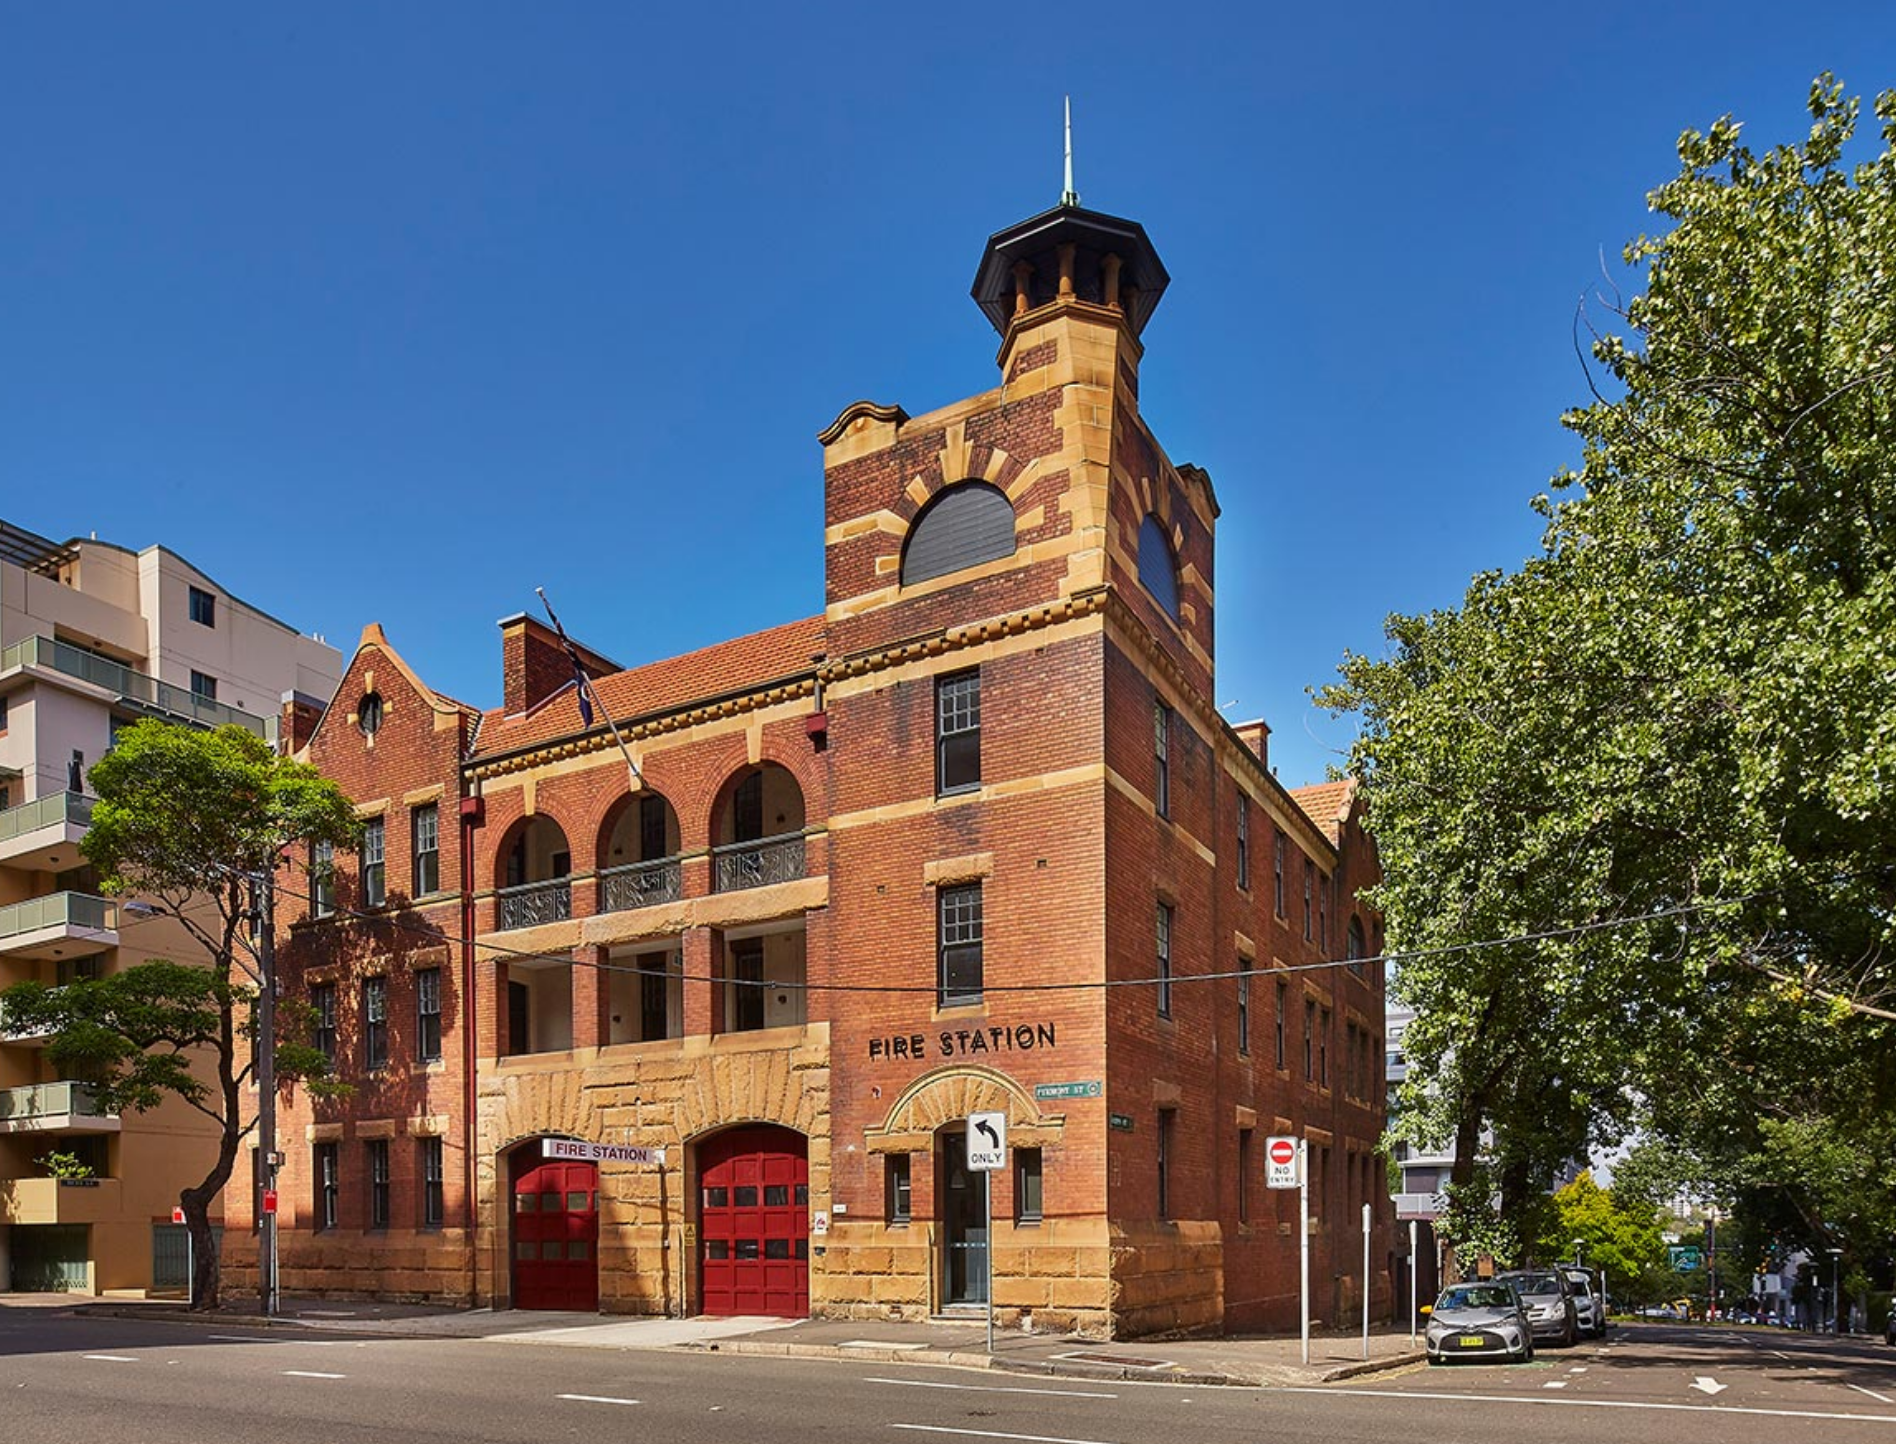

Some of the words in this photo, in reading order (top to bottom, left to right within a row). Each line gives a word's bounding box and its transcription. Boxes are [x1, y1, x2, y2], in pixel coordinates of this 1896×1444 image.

[869, 1034, 925, 1061] FIRE
[940, 1022, 1055, 1056] STATION
[556, 1143, 587, 1156] FIRE
[592, 1147, 647, 1161] STATION
[971, 1152, 1003, 1164] ONLY
[1274, 1166, 1290, 1175] NO
